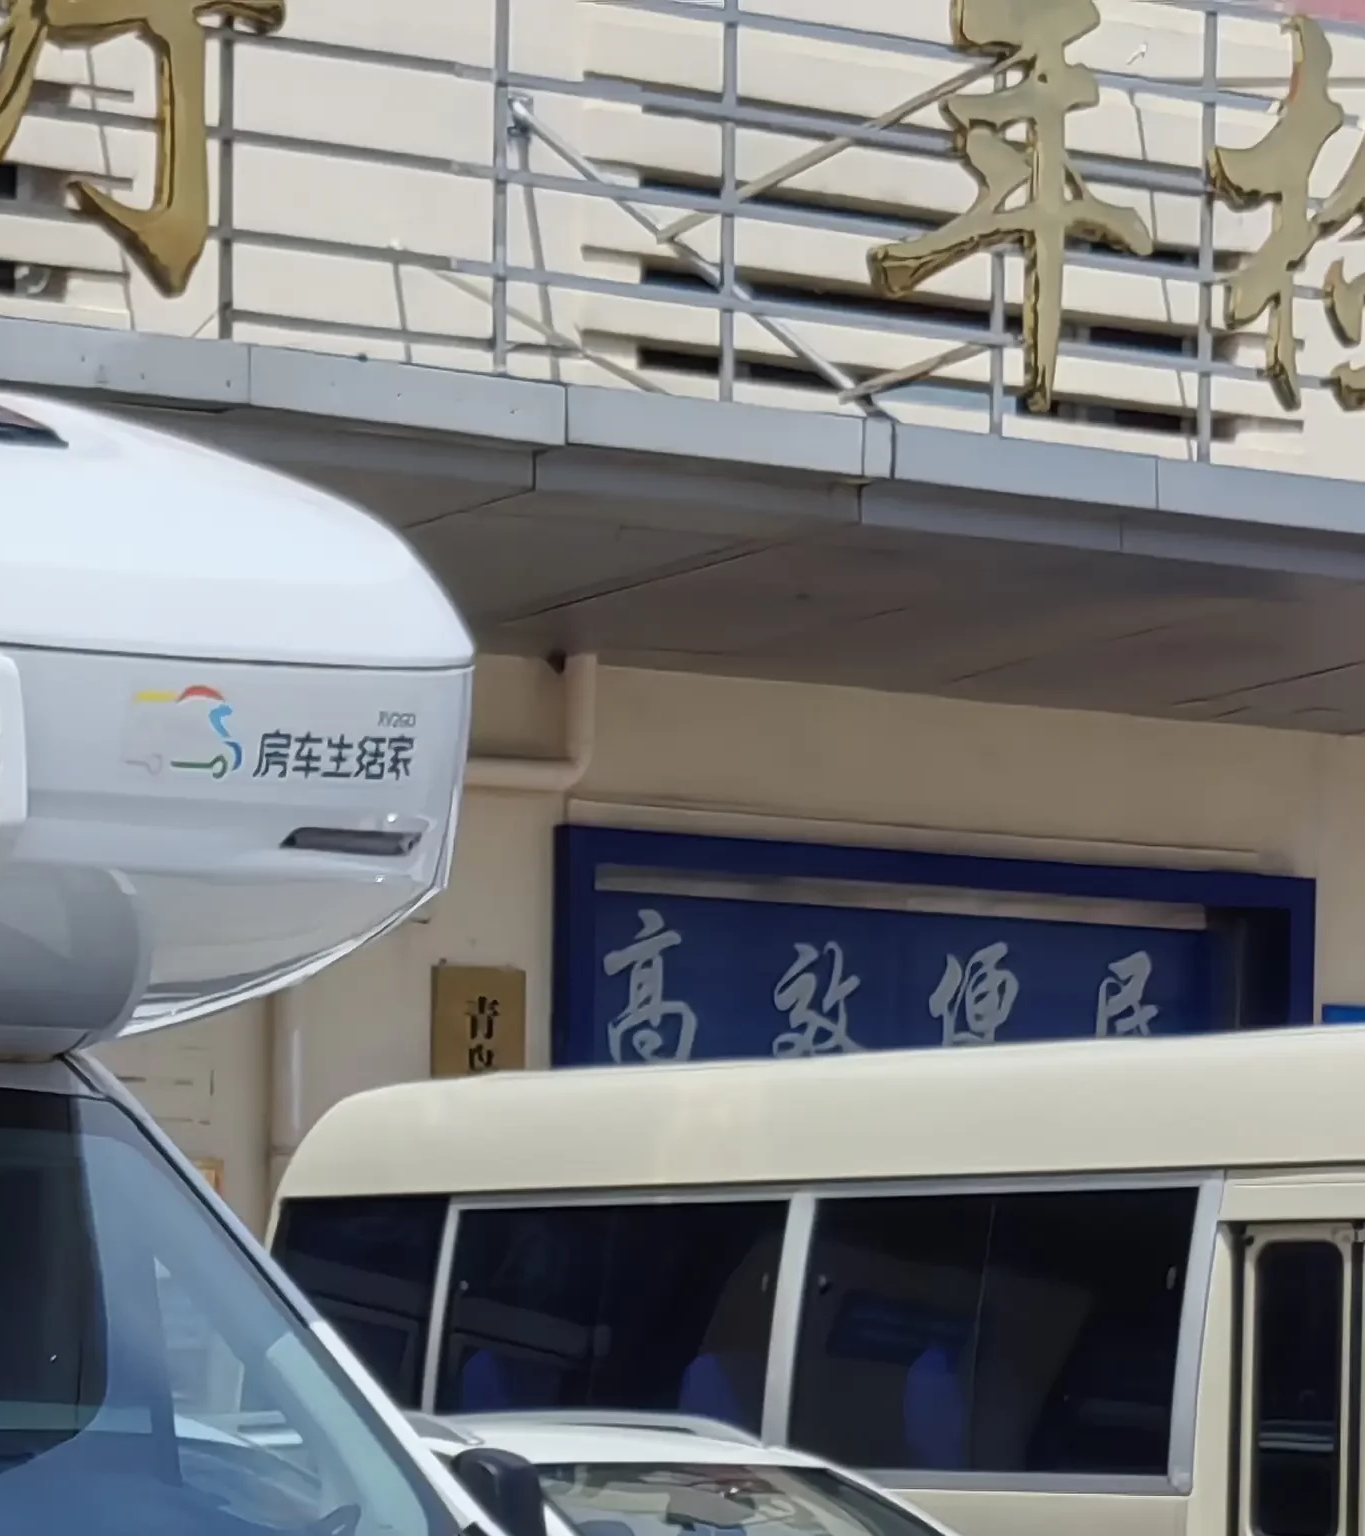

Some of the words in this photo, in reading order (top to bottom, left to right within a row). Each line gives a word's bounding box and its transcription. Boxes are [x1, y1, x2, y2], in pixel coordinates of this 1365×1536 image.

[252, 728, 416, 781] 房车生活家
